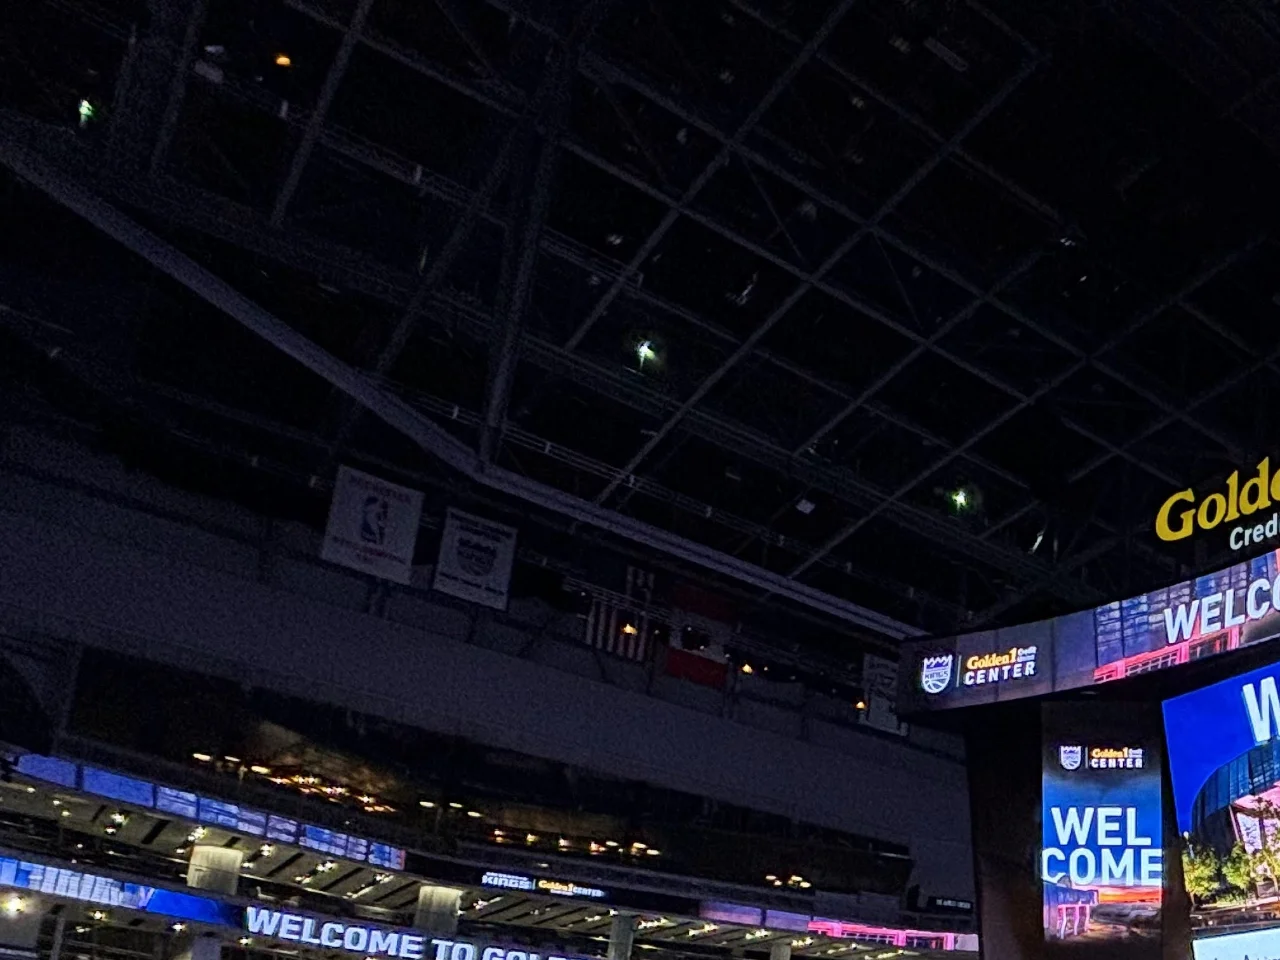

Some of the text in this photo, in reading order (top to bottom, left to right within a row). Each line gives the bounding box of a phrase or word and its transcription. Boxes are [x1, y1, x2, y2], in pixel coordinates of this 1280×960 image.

[963, 661, 1036, 686] CENTER
[1091, 758, 1144, 769] CENTER
[1050, 806, 1152, 846] WEL
[482, 875, 533, 890] KINGS
[1041, 847, 1163, 887] COME
[246, 906, 424, 960] WELCOME
